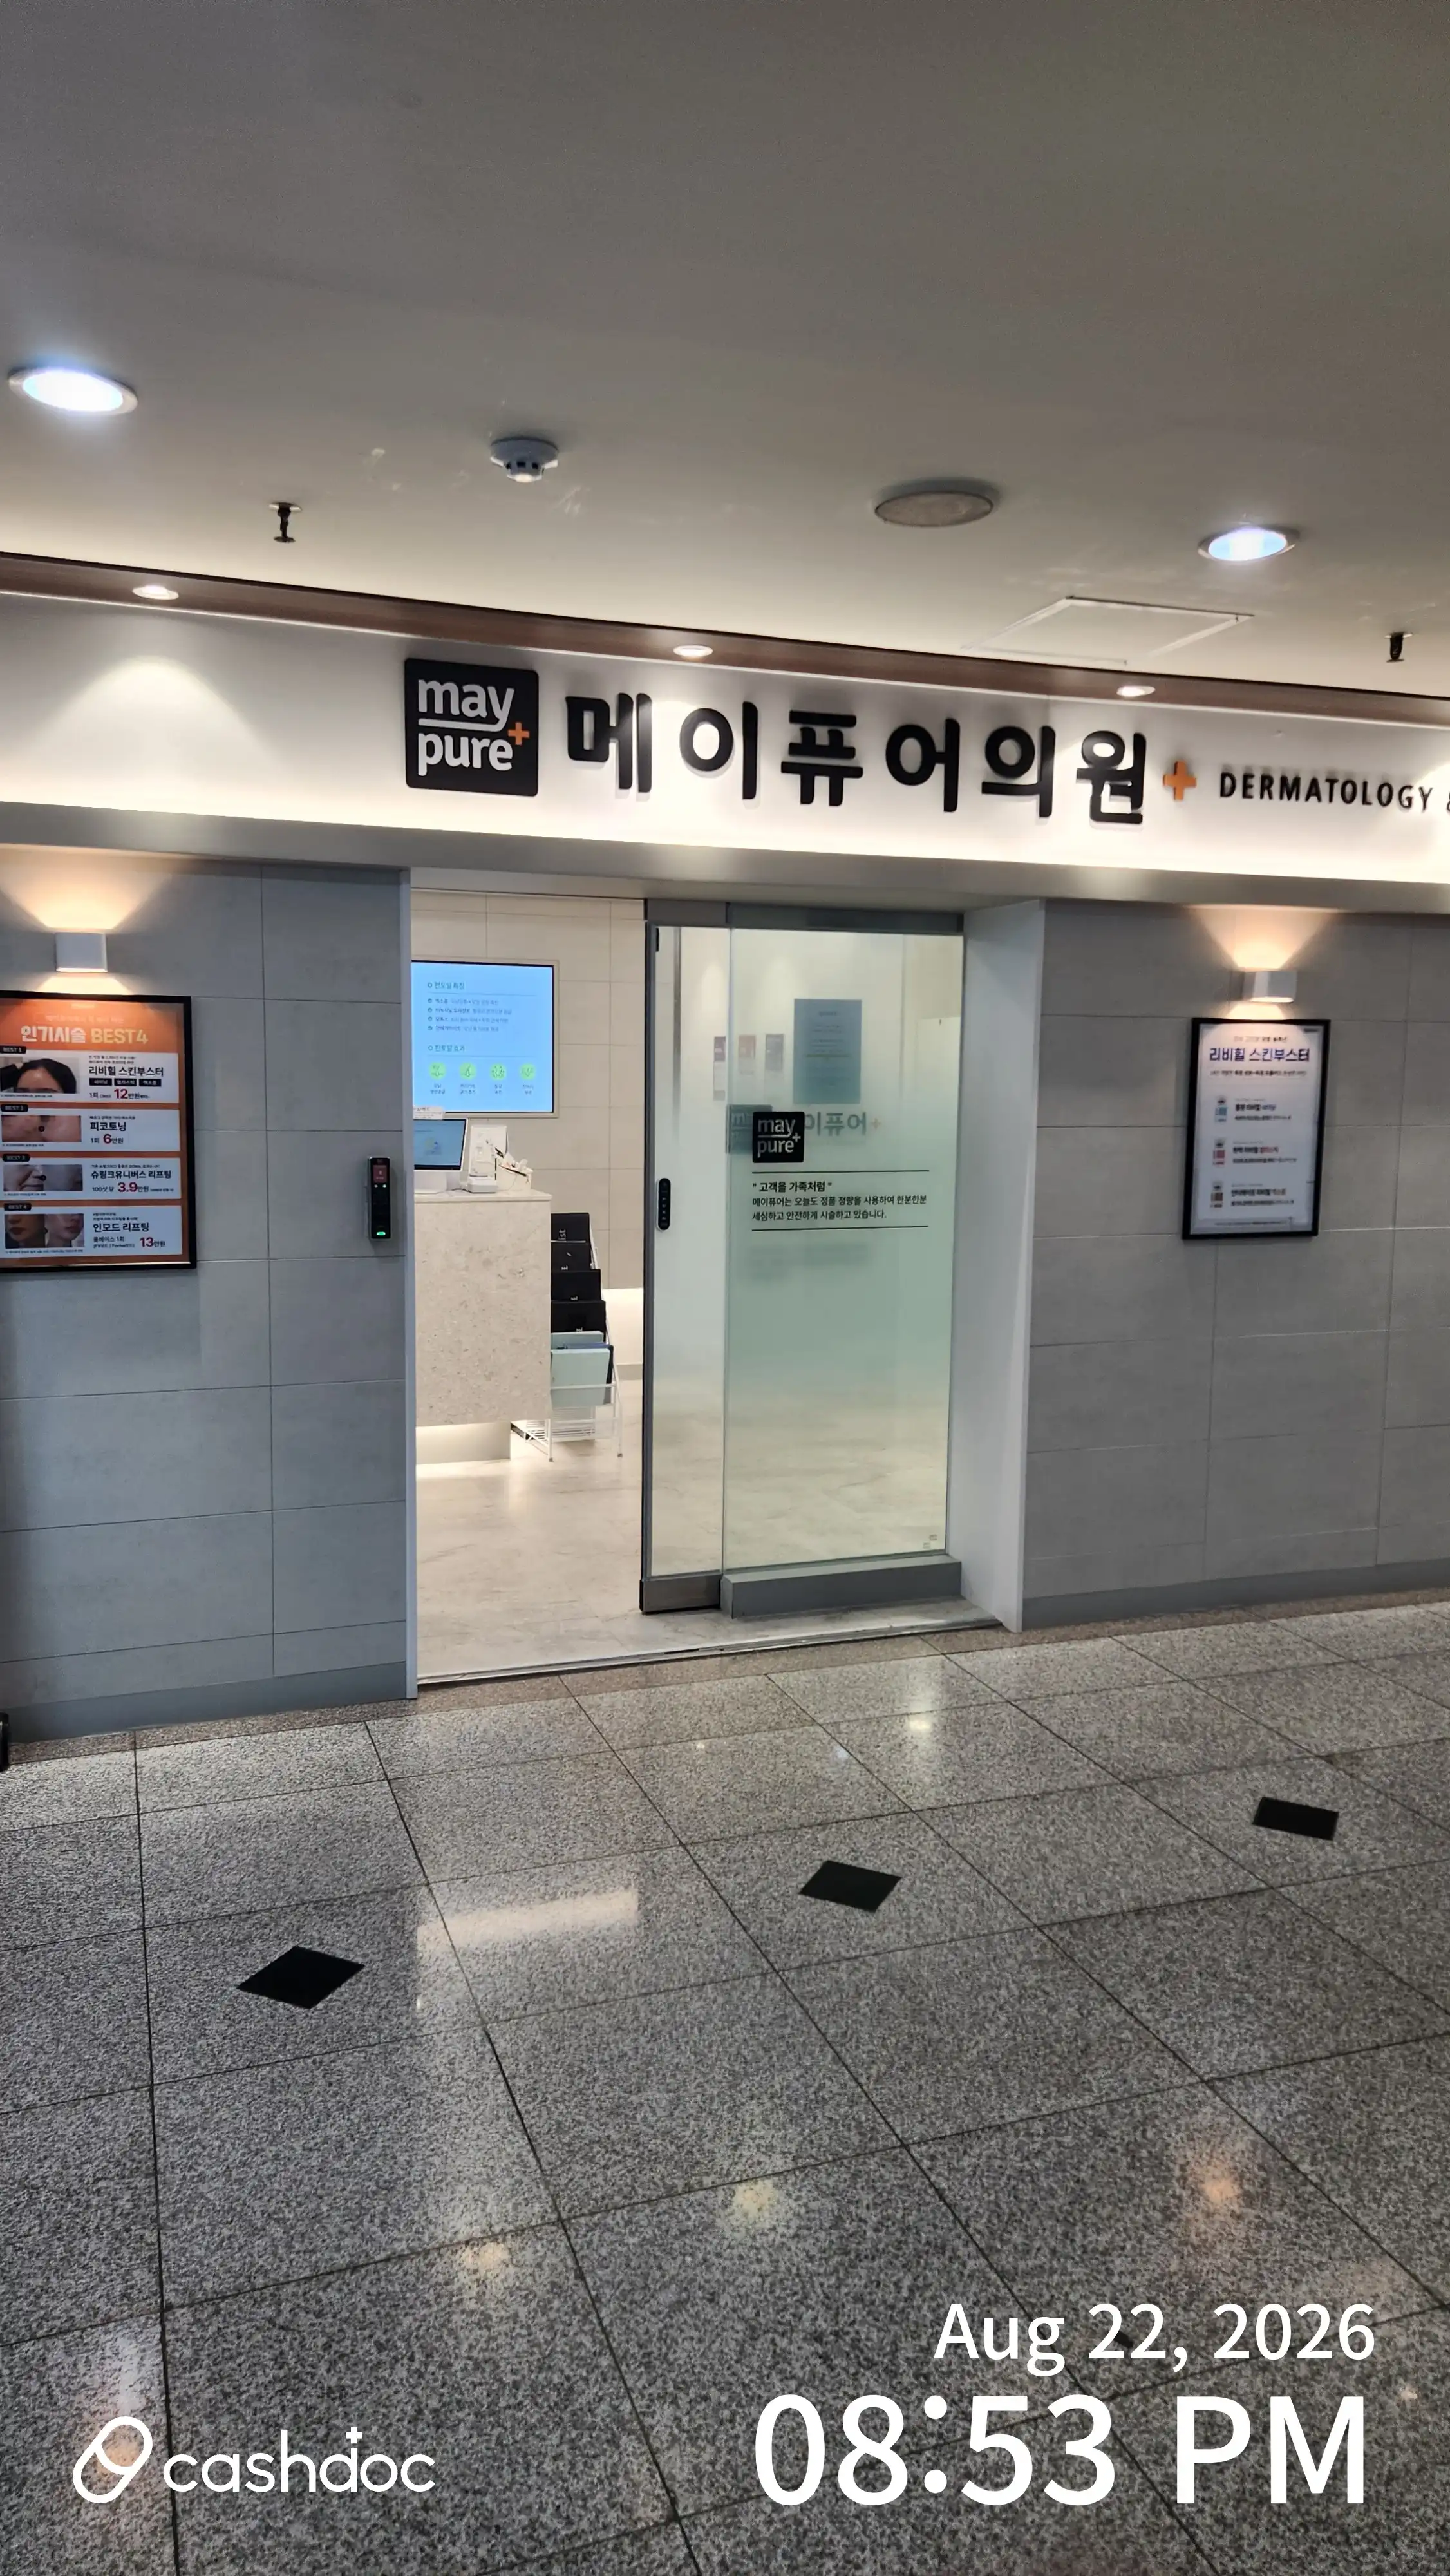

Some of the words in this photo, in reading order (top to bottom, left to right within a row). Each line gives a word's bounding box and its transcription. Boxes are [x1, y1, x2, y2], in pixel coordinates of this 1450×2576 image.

[418, 679, 514, 732] may
[418, 732, 513, 777] pure
[566, 692, 1147, 824] 메이퓨어의원
[1219, 771, 1433, 811] DERMATOLOGY
[21, 1025, 86, 1043] 인기시술
[1210, 1047, 1245, 1061] 리비힐
[1249, 1048, 1310, 1062] 스킨부스터
[89, 1066, 117, 1077] 리비힐
[118, 1067, 164, 1077] 스킨부스터
[90, 1122, 127, 1132] 피코토닝
[758, 1119, 796, 1138] may
[804, 1111, 867, 1136] 이퓨어
[757, 1139, 795, 1158] pure
[91, 1170, 147, 1179] 슈링크유니버스
[149, 1170, 171, 1179] 리프팅
[758, 1182, 787, 1193] 고객을
[789, 1182, 825, 1192] 가족처럼
[752, 1197, 792, 1207] 메이퓨어는
[794, 1197, 818, 1206] 오늘도
[820, 1197, 836, 1206] 정품
[838, 1196, 862, 1206] 정량을
[864, 1196, 895, 1205] 사용하여
[897, 1195, 927, 1205] 한분한분
[752, 1211, 784, 1221] 세심하고
[786, 1211, 818, 1220] 안전하게
[820, 1210, 851, 1220] 시술하고
[854, 1209, 887, 1220] 있습니다.
[93, 1223, 121, 1233] 인모드
[123, 1223, 149, 1233] 리프팅
